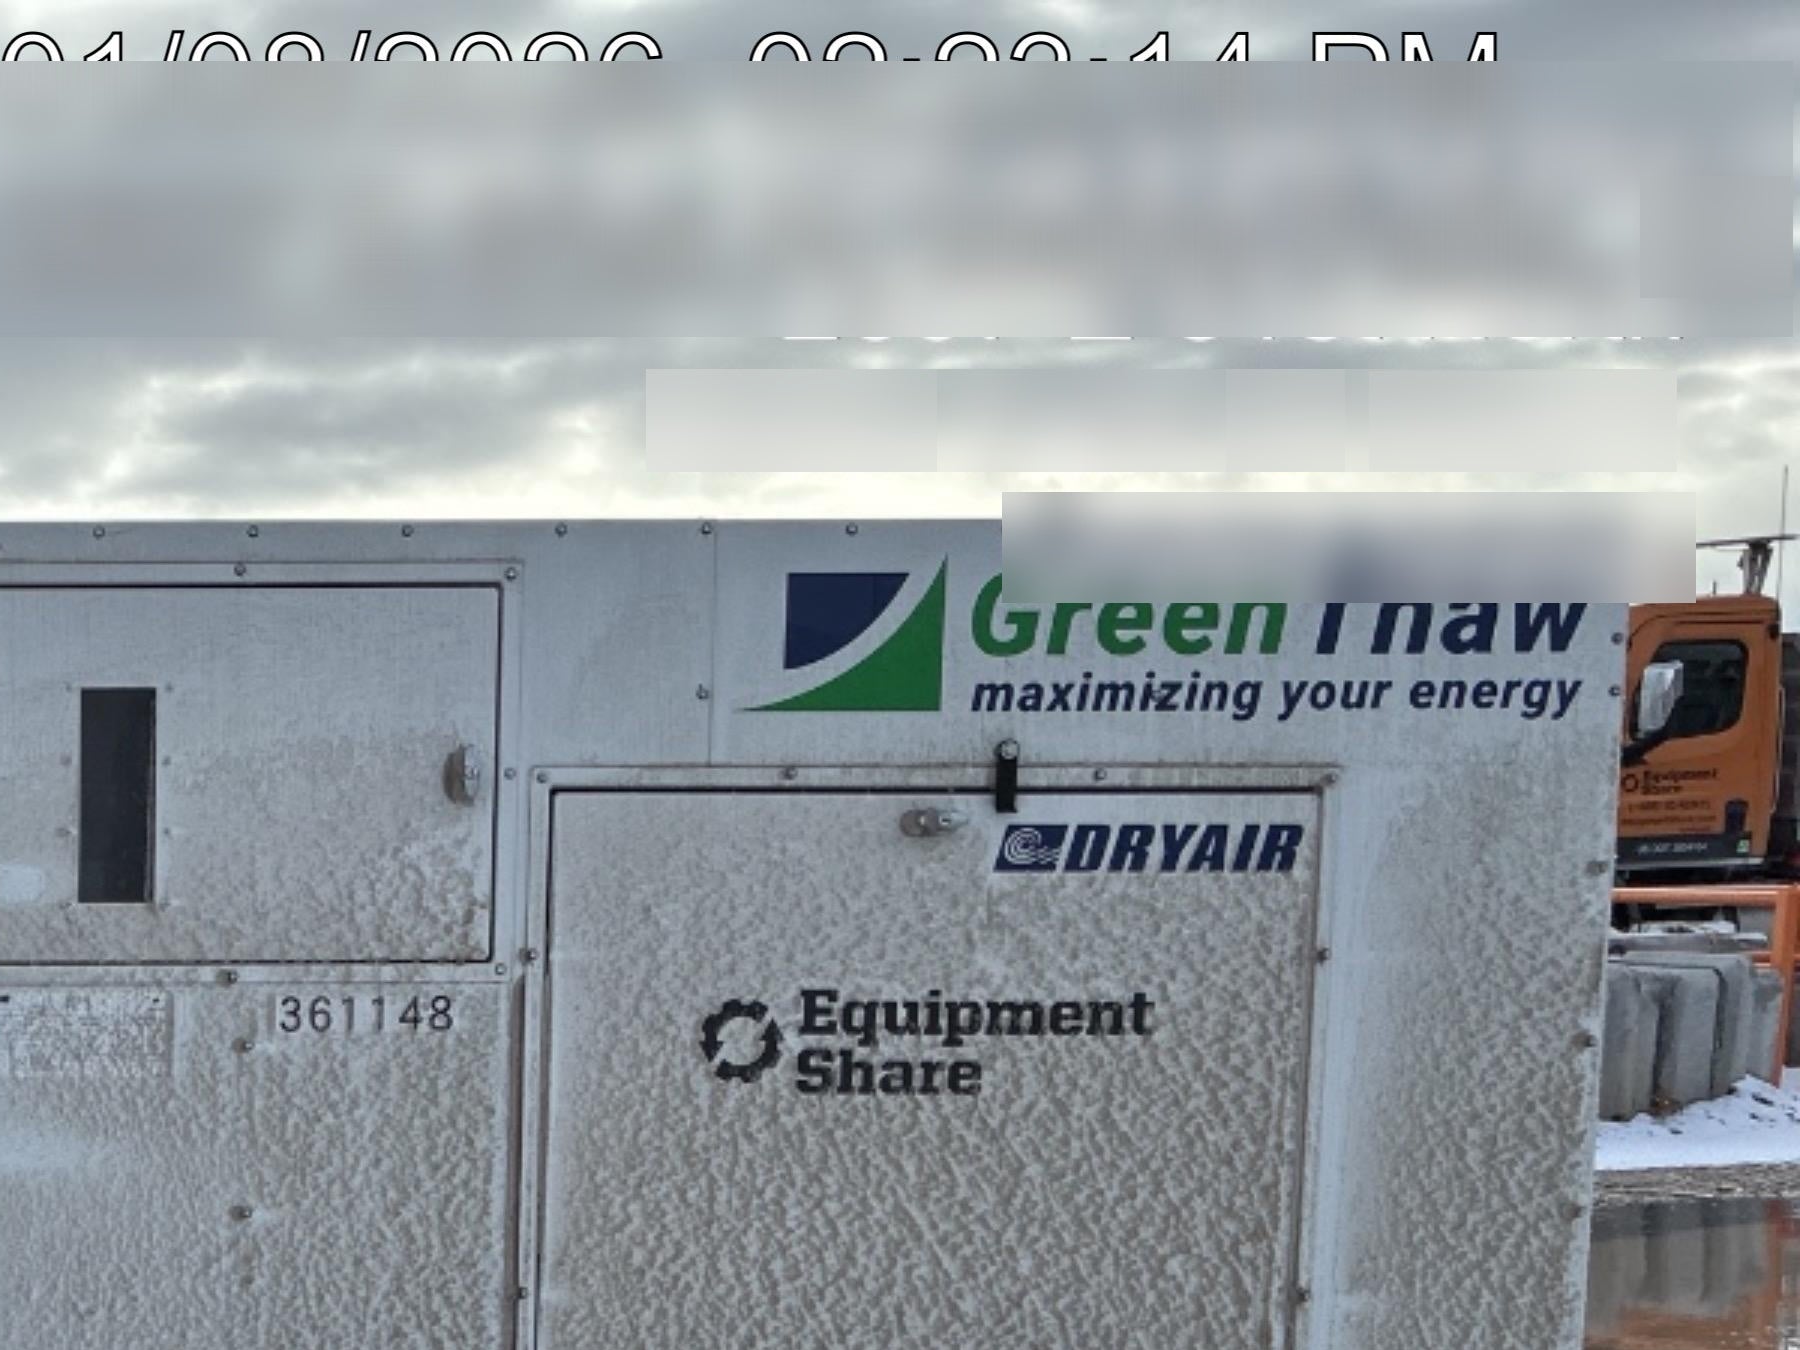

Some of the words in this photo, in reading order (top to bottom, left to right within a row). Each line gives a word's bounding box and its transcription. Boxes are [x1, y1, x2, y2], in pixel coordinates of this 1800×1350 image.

[971, 671, 1263, 721] maximizing
[1277, 679, 1392, 721] your
[1408, 679, 1582, 720] energy
[1063, 823, 1305, 872] DRYAIR
[279, 995, 454, 1033] 361148
[800, 989, 1155, 1046] Equipment
[796, 1048, 983, 1096] Share
